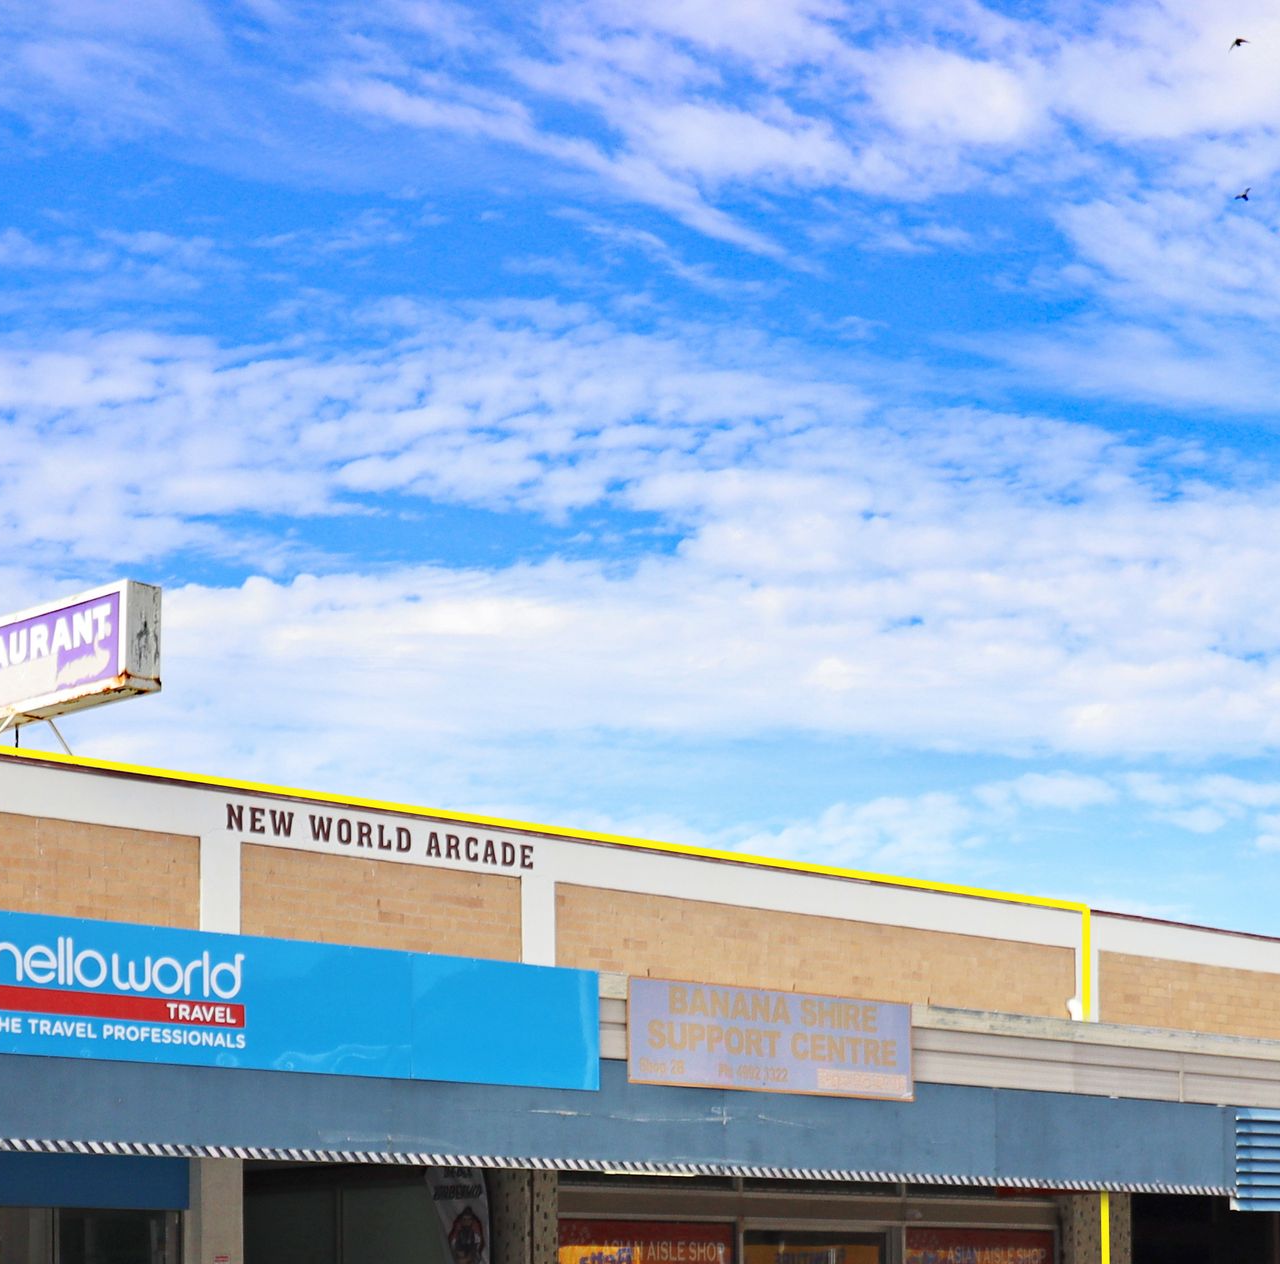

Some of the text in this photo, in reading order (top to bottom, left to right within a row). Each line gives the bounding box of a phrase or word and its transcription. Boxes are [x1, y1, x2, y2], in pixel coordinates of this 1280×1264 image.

[226, 803, 535, 870] NEW WORLD ARCADE
[166, 1002, 237, 1024] TRAVEL
[668, 986, 878, 1033] BANANA SHIRE
[28, 1018, 98, 1041] TRAVEL
[102, 1025, 247, 1050] PROFESSIONALS
[647, 1019, 898, 1068] SUPPORT CENTRE
[647, 1240, 686, 1261] AISLE
[688, 1242, 726, 1263] SHOP
[984, 1247, 1015, 1264] AISLE
